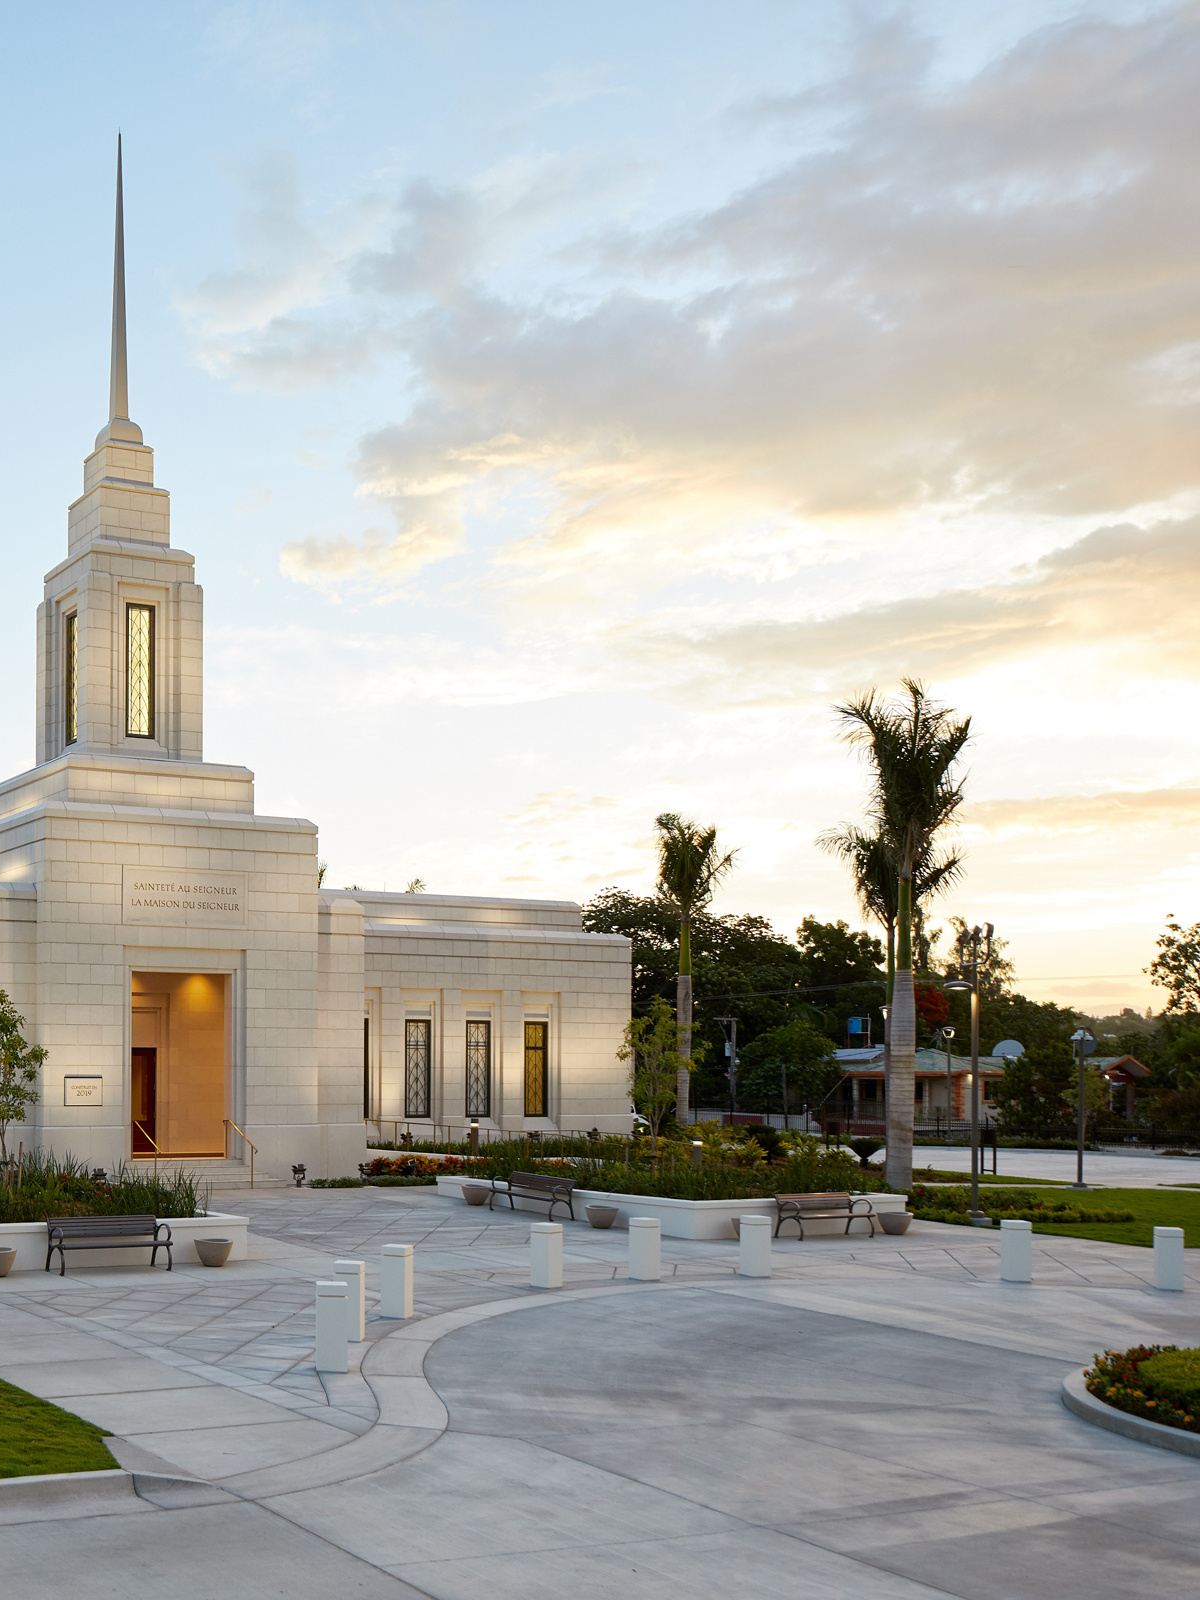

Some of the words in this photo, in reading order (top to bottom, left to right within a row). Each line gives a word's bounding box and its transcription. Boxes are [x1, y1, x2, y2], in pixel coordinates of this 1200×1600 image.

[133, 882, 175, 892] SAINTETÉ
[177, 885, 190, 893] AU
[193, 885, 237, 895] SEIGNEUR
[131, 898, 142, 906] LA
[143, 899, 180, 908] MAISON
[182, 901, 195, 909] DU
[197, 902, 240, 911] SEIGNEUR
